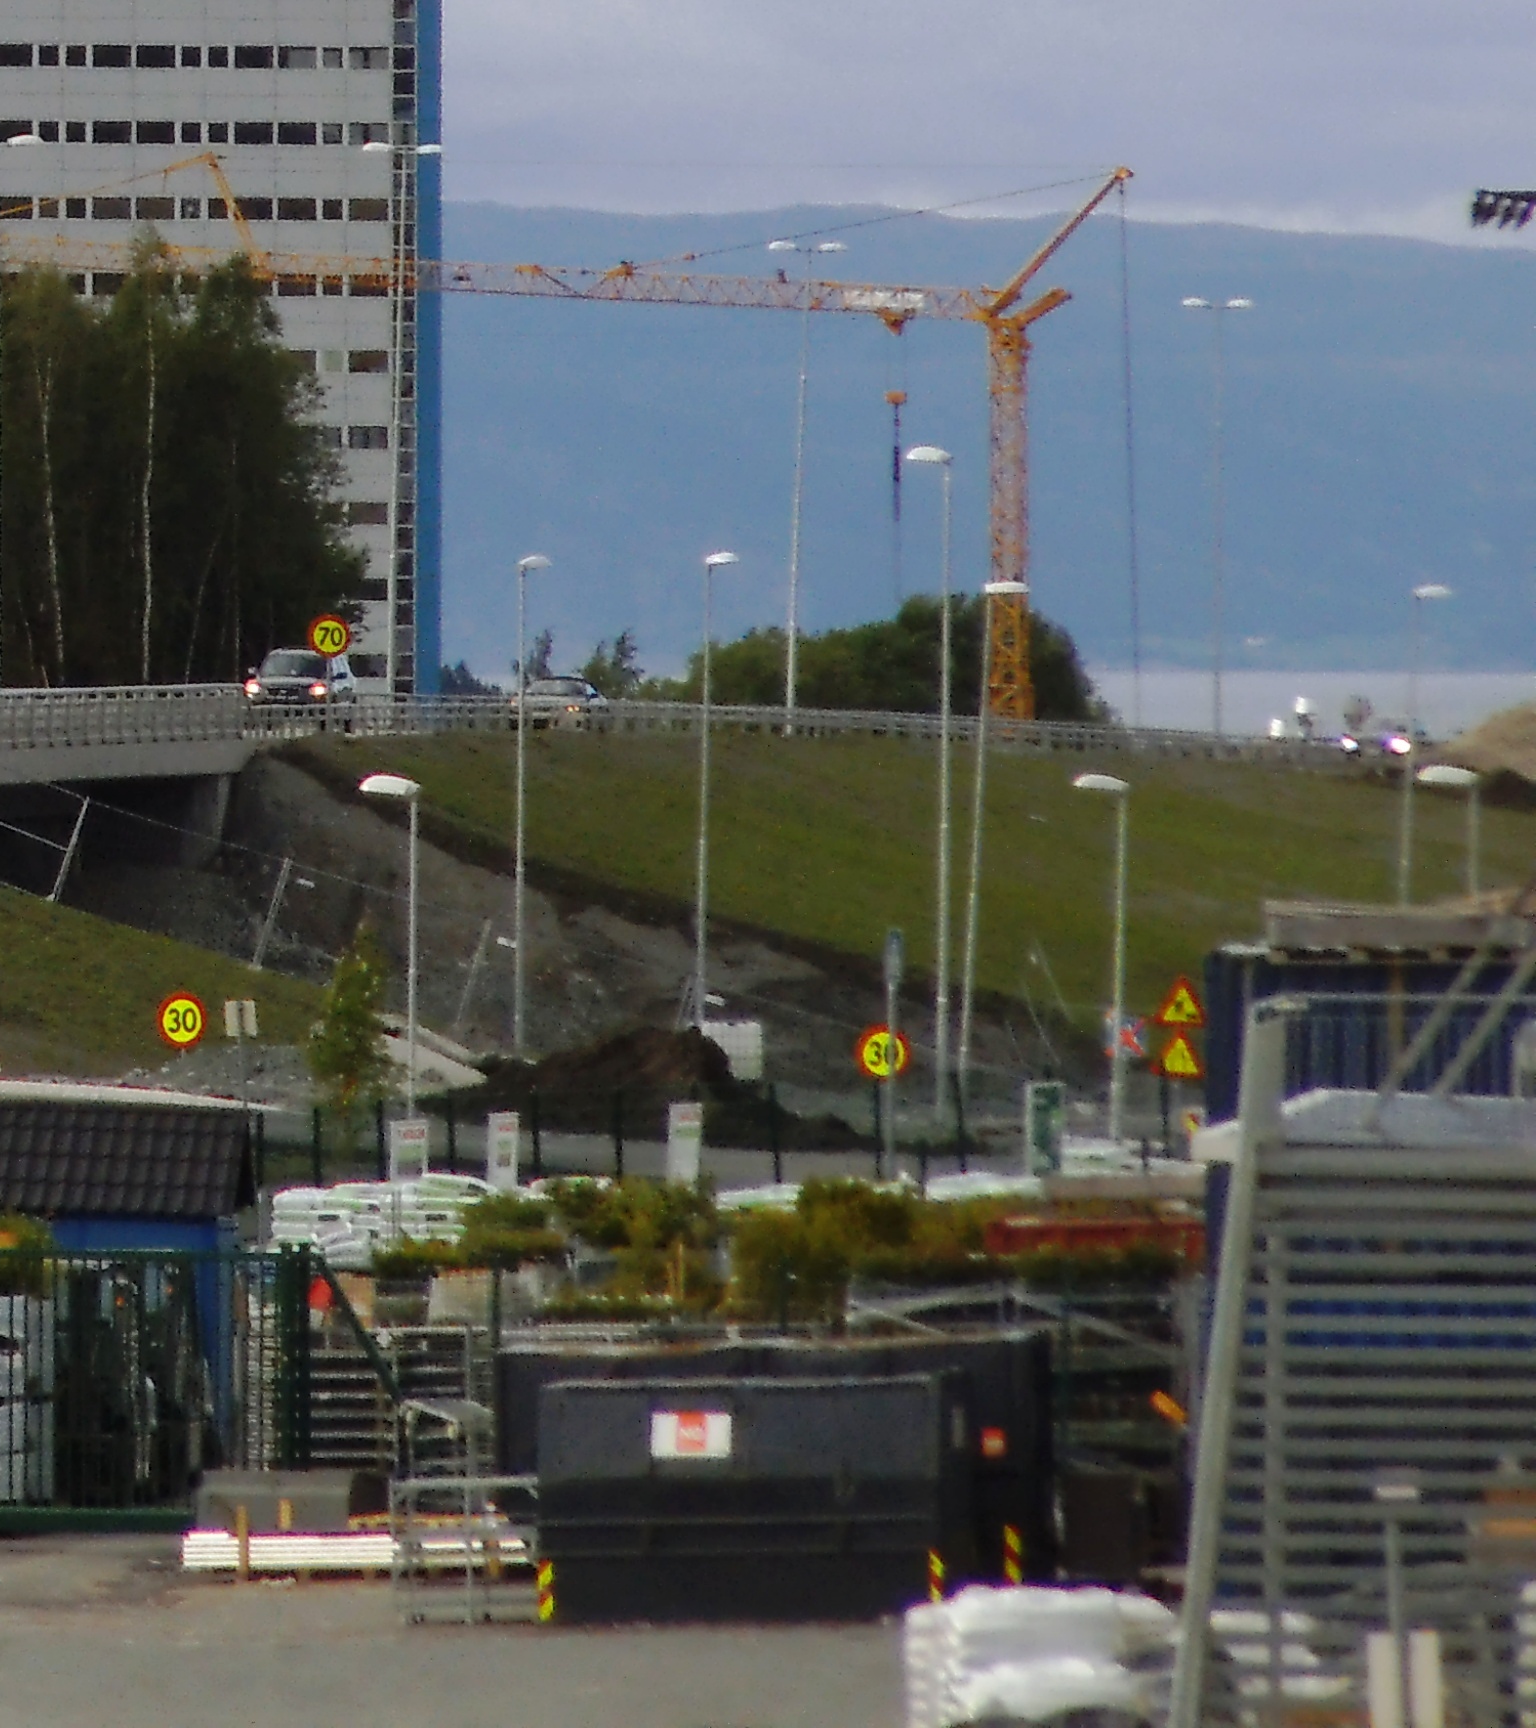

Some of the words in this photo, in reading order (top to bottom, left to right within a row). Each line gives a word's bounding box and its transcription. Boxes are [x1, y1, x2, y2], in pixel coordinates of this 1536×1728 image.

[318, 626, 343, 647] 70
[167, 1007, 197, 1034] 30
[869, 1041, 899, 1067] 30
